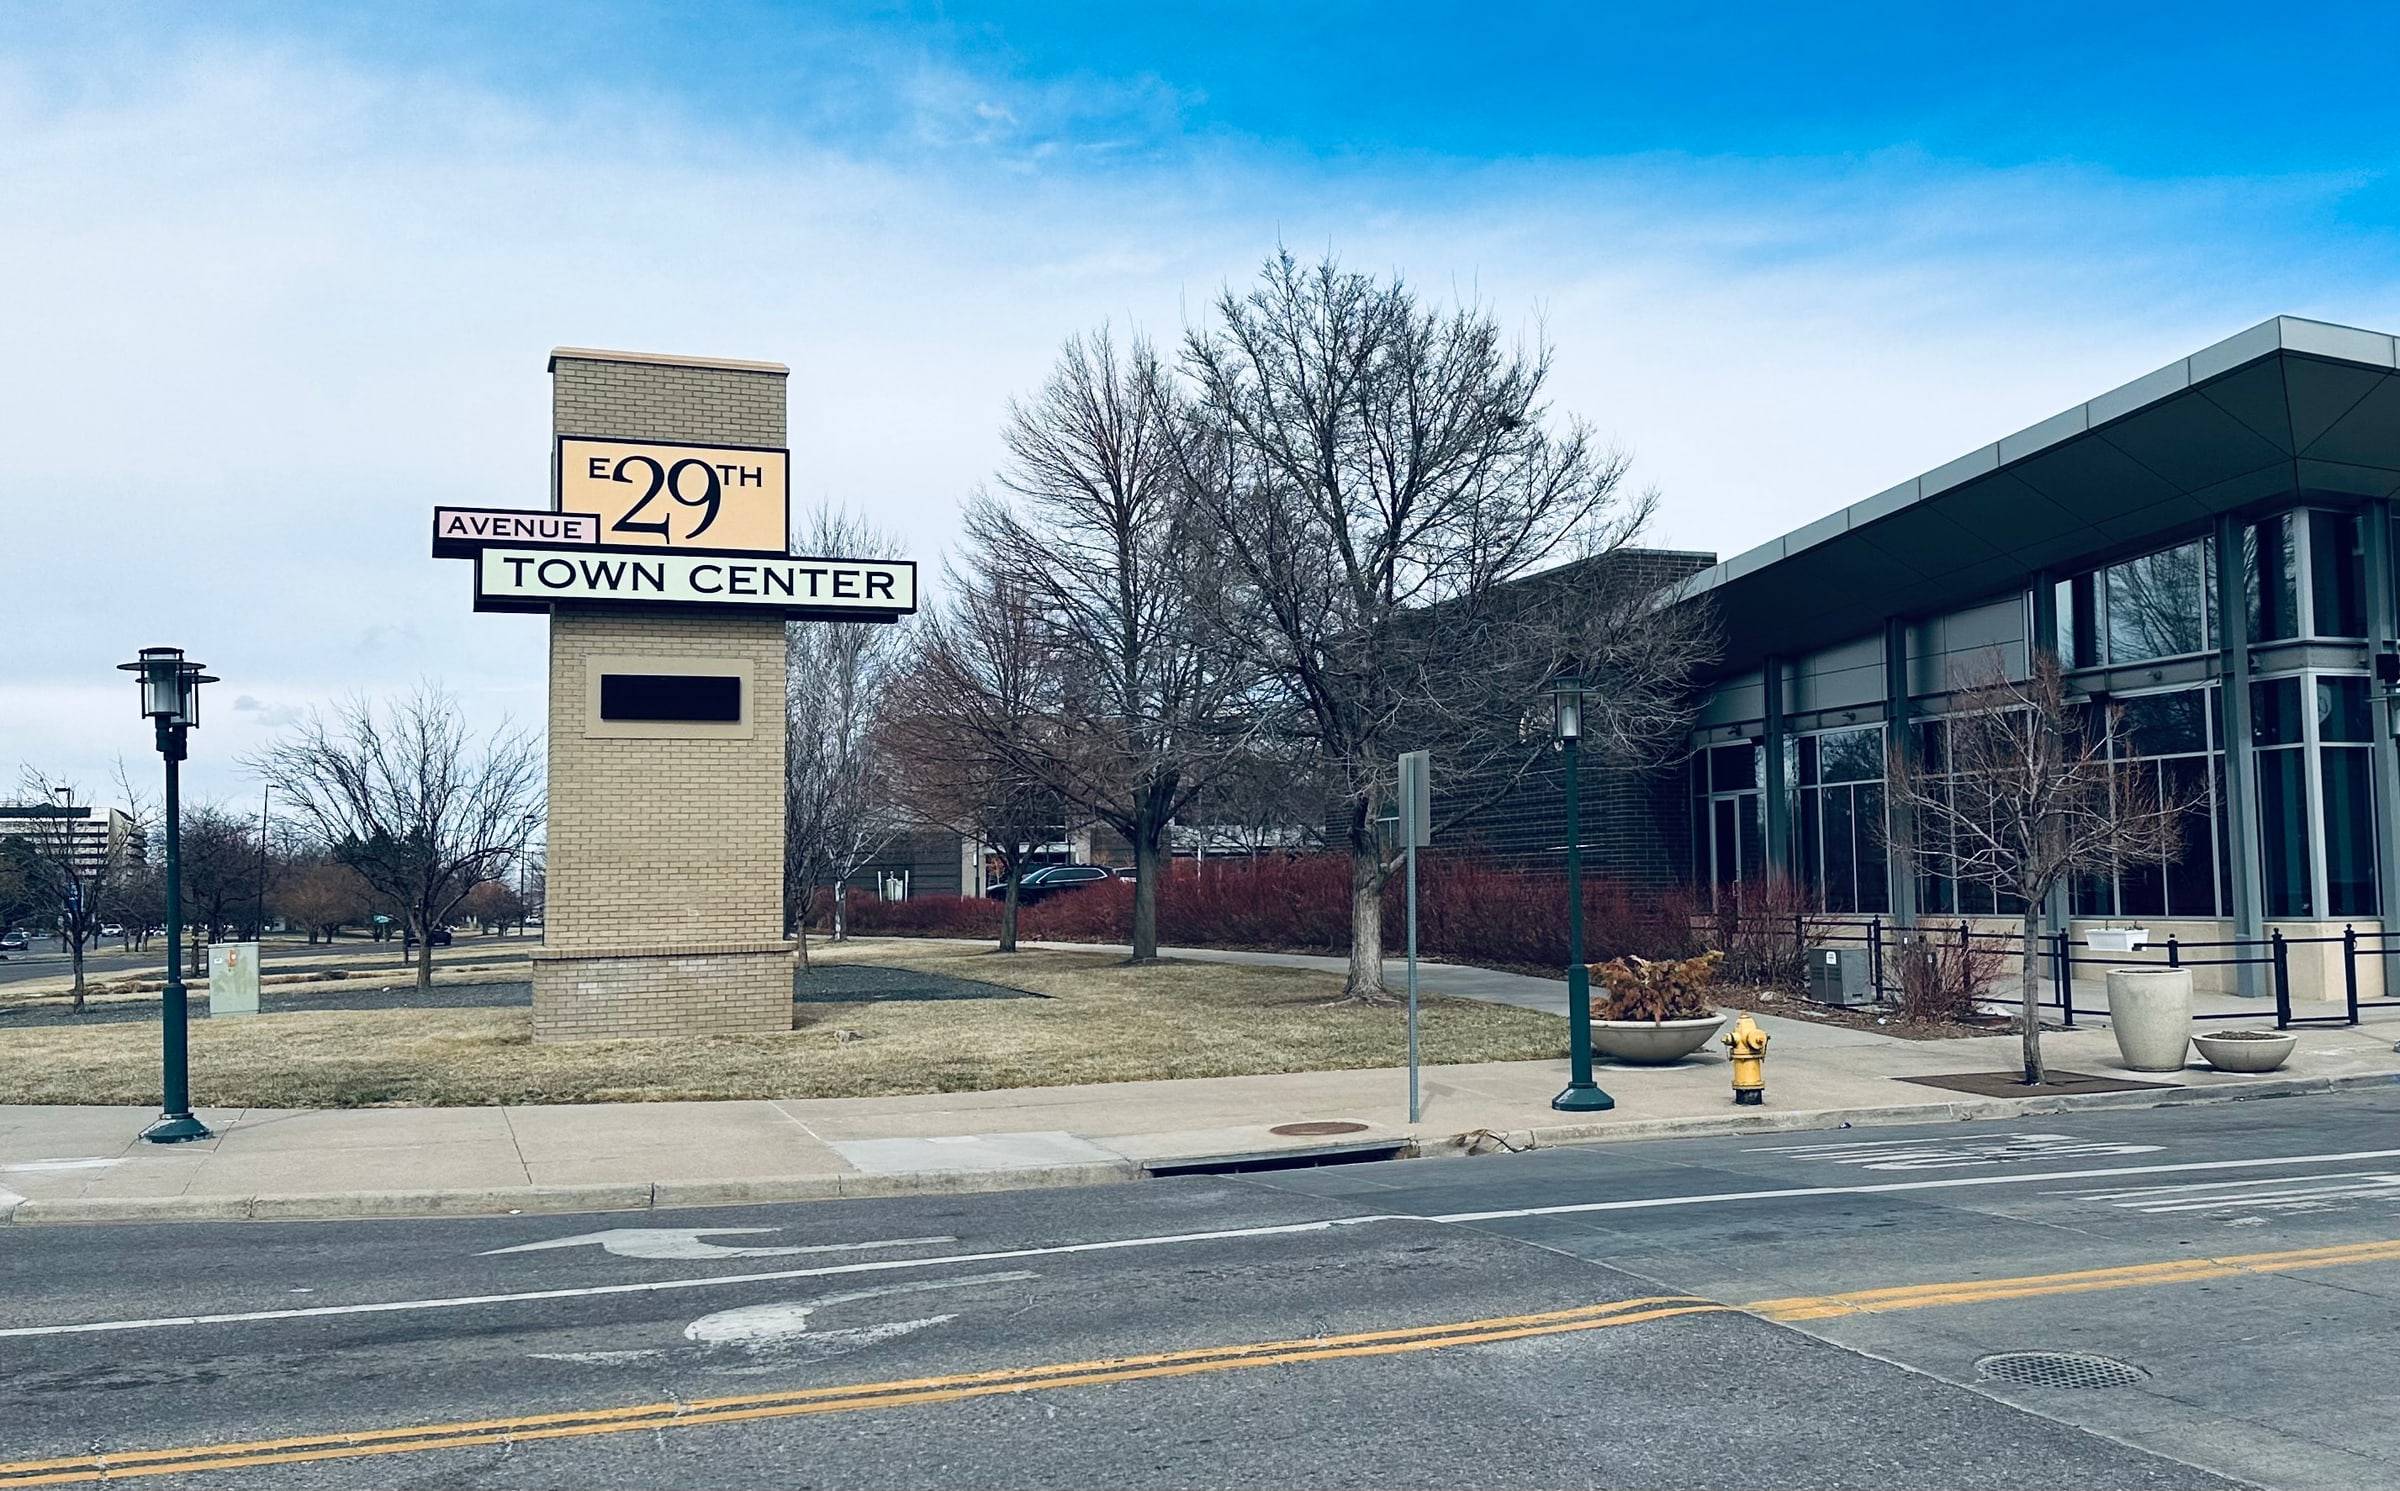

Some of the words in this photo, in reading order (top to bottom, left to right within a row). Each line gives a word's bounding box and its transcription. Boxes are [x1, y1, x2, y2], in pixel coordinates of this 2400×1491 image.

[446, 515, 583, 541] AVENUE
[502, 556, 666, 593] TOWN
[688, 564, 897, 601] CENTER
